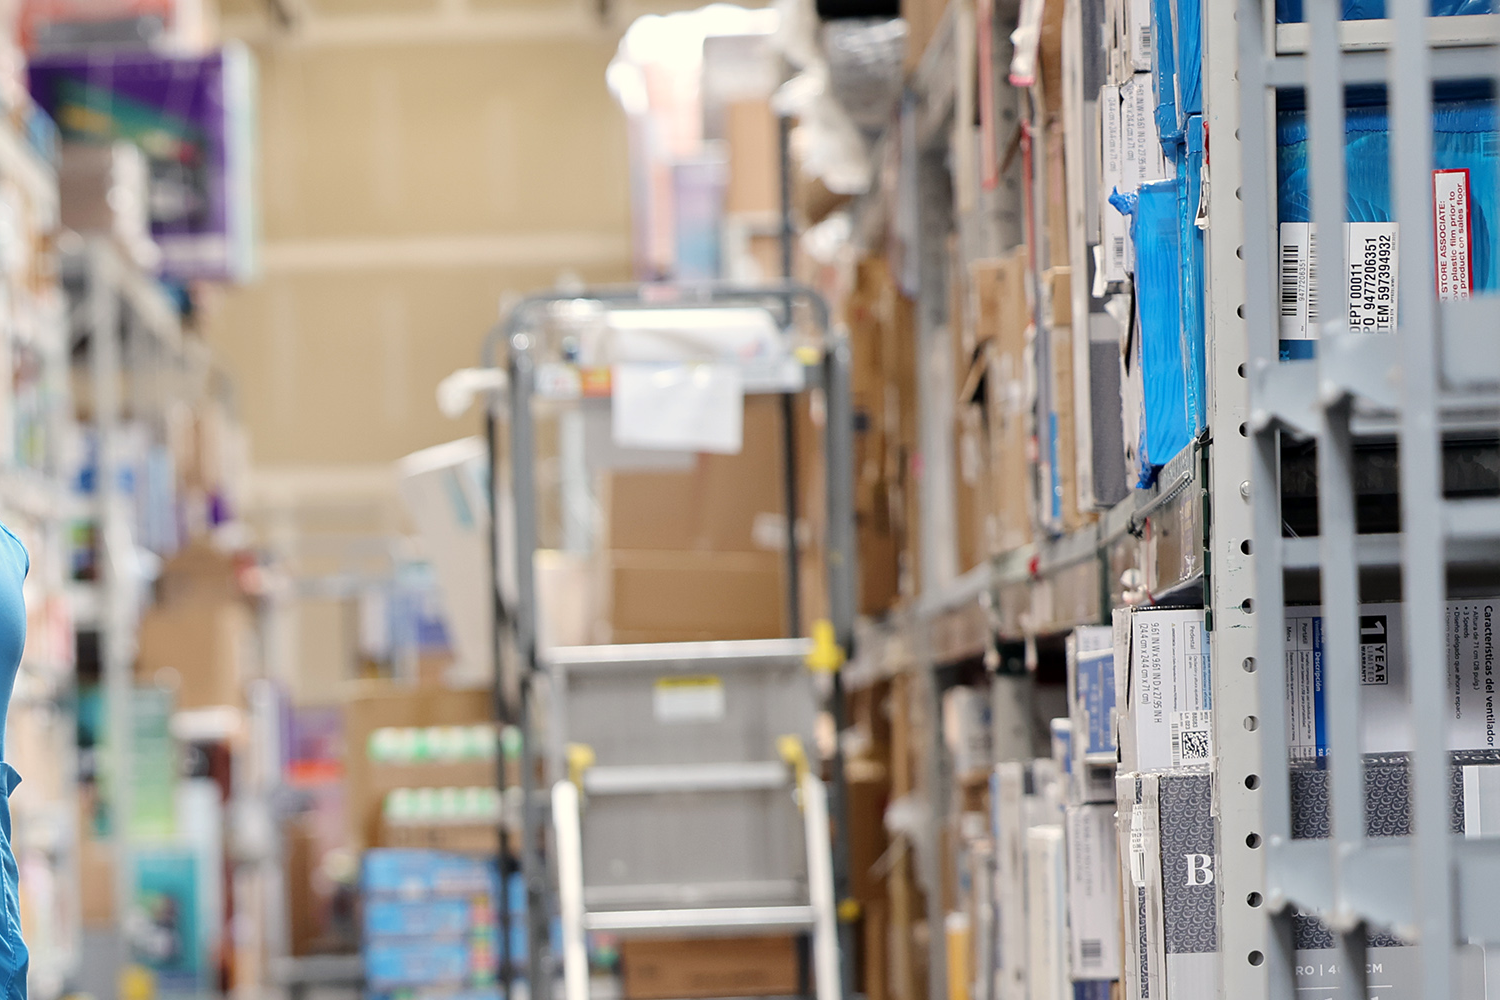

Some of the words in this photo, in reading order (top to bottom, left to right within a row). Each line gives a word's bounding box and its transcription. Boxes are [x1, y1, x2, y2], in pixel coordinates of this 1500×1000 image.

[1449, 191, 1455, 201] to
[1449, 204, 1457, 226] prior
[1438, 201, 1447, 258] ASSOCIATE:
[1458, 237, 1464, 248] on
[1378, 235, 1391, 301] 597394932
[1450, 249, 1458, 281] plastic
[1458, 251, 1467, 289] product
[1350, 264, 1362, 299] 00011
[1364, 238, 1377, 310] 9477206351
[1440, 261, 1448, 293] STORE
[1349, 303, 1361, 334] DEPT
[1377, 305, 1389, 334] TEM
[1139, 623, 1149, 639] (24.4
[1150, 622, 1161, 635] 9.61
[1361, 620, 1384, 635] 1
[1473, 632, 1479, 640] de
[1141, 639, 1148, 649] cm
[1484, 606, 1494, 675] Características
[1141, 655, 1150, 668] 24.4
[1473, 650, 1479, 659] cm
[1151, 658, 1161, 671] 9.61
[1314, 652, 1322, 691] Descripción
[1375, 645, 1385, 682] YEAR
[1141, 669, 1150, 678] cm
[1153, 672, 1161, 680] IN
[1142, 684, 1151, 692] 71
[1486, 679, 1495, 693] del
[1141, 693, 1151, 705] cm)
[1152, 691, 1162, 709] 27.95
[1486, 696, 1495, 746] ventilador
